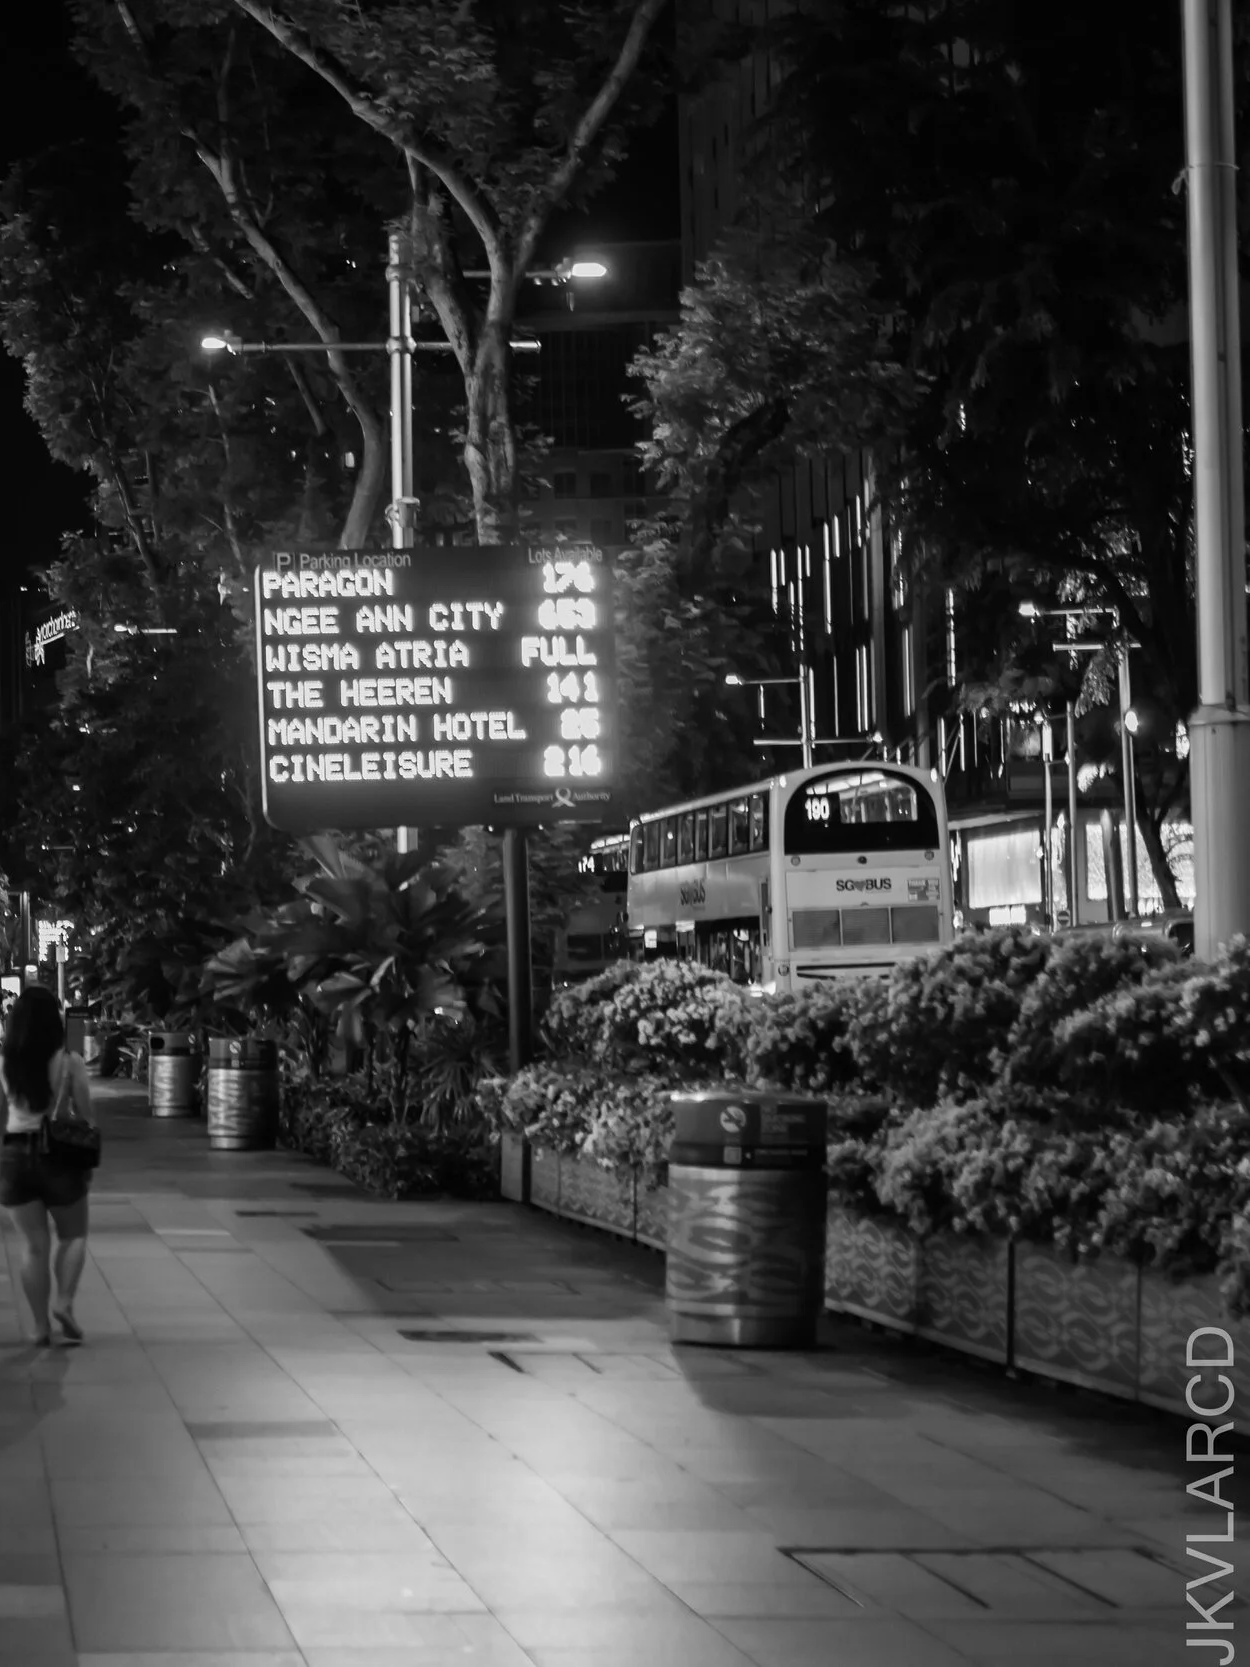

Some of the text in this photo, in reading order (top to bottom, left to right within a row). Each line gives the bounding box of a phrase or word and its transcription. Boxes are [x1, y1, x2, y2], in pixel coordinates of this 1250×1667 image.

[300, 553, 351, 570] Parking
[354, 552, 412, 568] Location
[528, 547, 603, 564] Lots Available
[262, 568, 394, 598] PARAGON
[264, 607, 339, 635] NGEE
[356, 604, 413, 632] ANN
[429, 602, 504, 631] CITY
[265, 635, 597, 672] WISMA ATRIA FULL
[267, 680, 324, 708] THE
[340, 677, 453, 706] HEEREN
[268, 714, 418, 745] MANDARIN
[433, 711, 526, 741] HOTEL
[269, 750, 473, 782] CINELEISURE
[573, 791, 611, 802] Authority
[805, 797, 830, 821] 190
